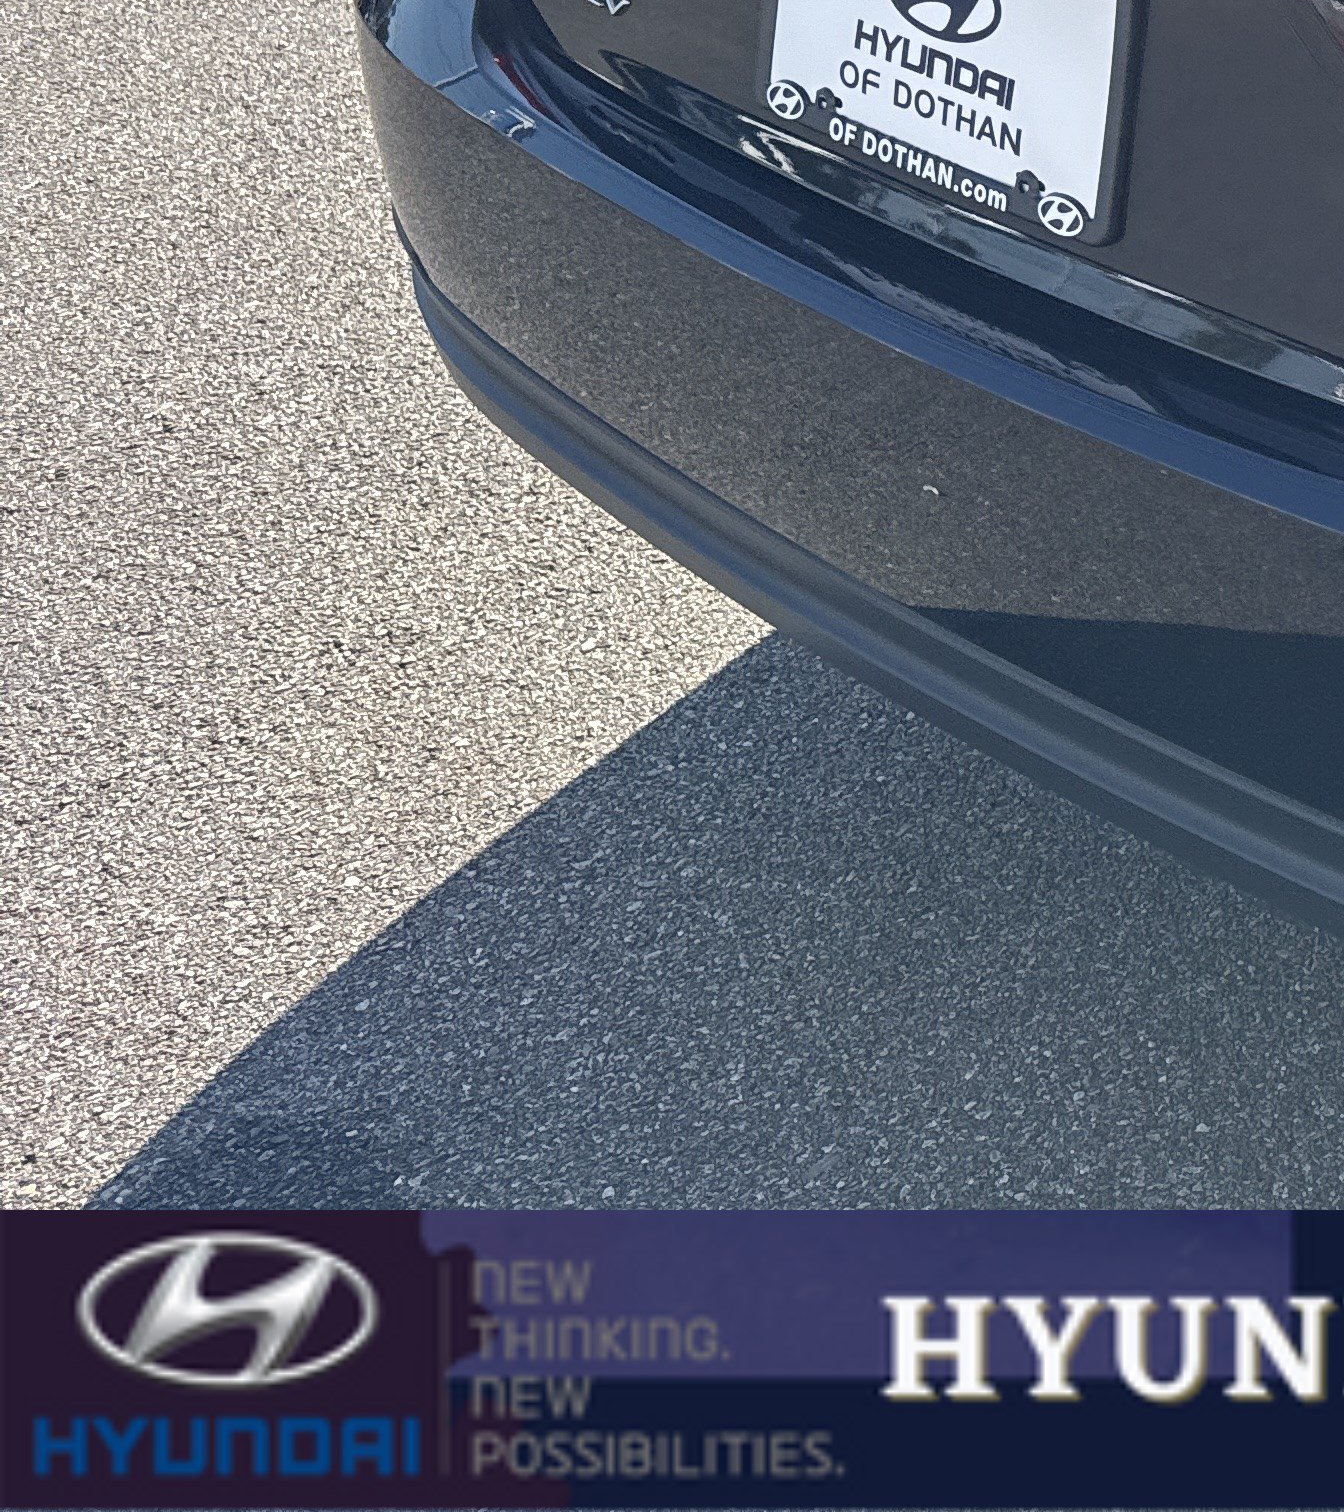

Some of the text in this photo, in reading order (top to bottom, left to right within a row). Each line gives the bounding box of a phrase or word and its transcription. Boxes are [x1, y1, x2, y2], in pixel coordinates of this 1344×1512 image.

[839, 59, 1023, 157] OF DOTHAN
[852, 18, 1017, 111] HYUNDAI
[828, 115, 1008, 213] OF DOTHAN.com
